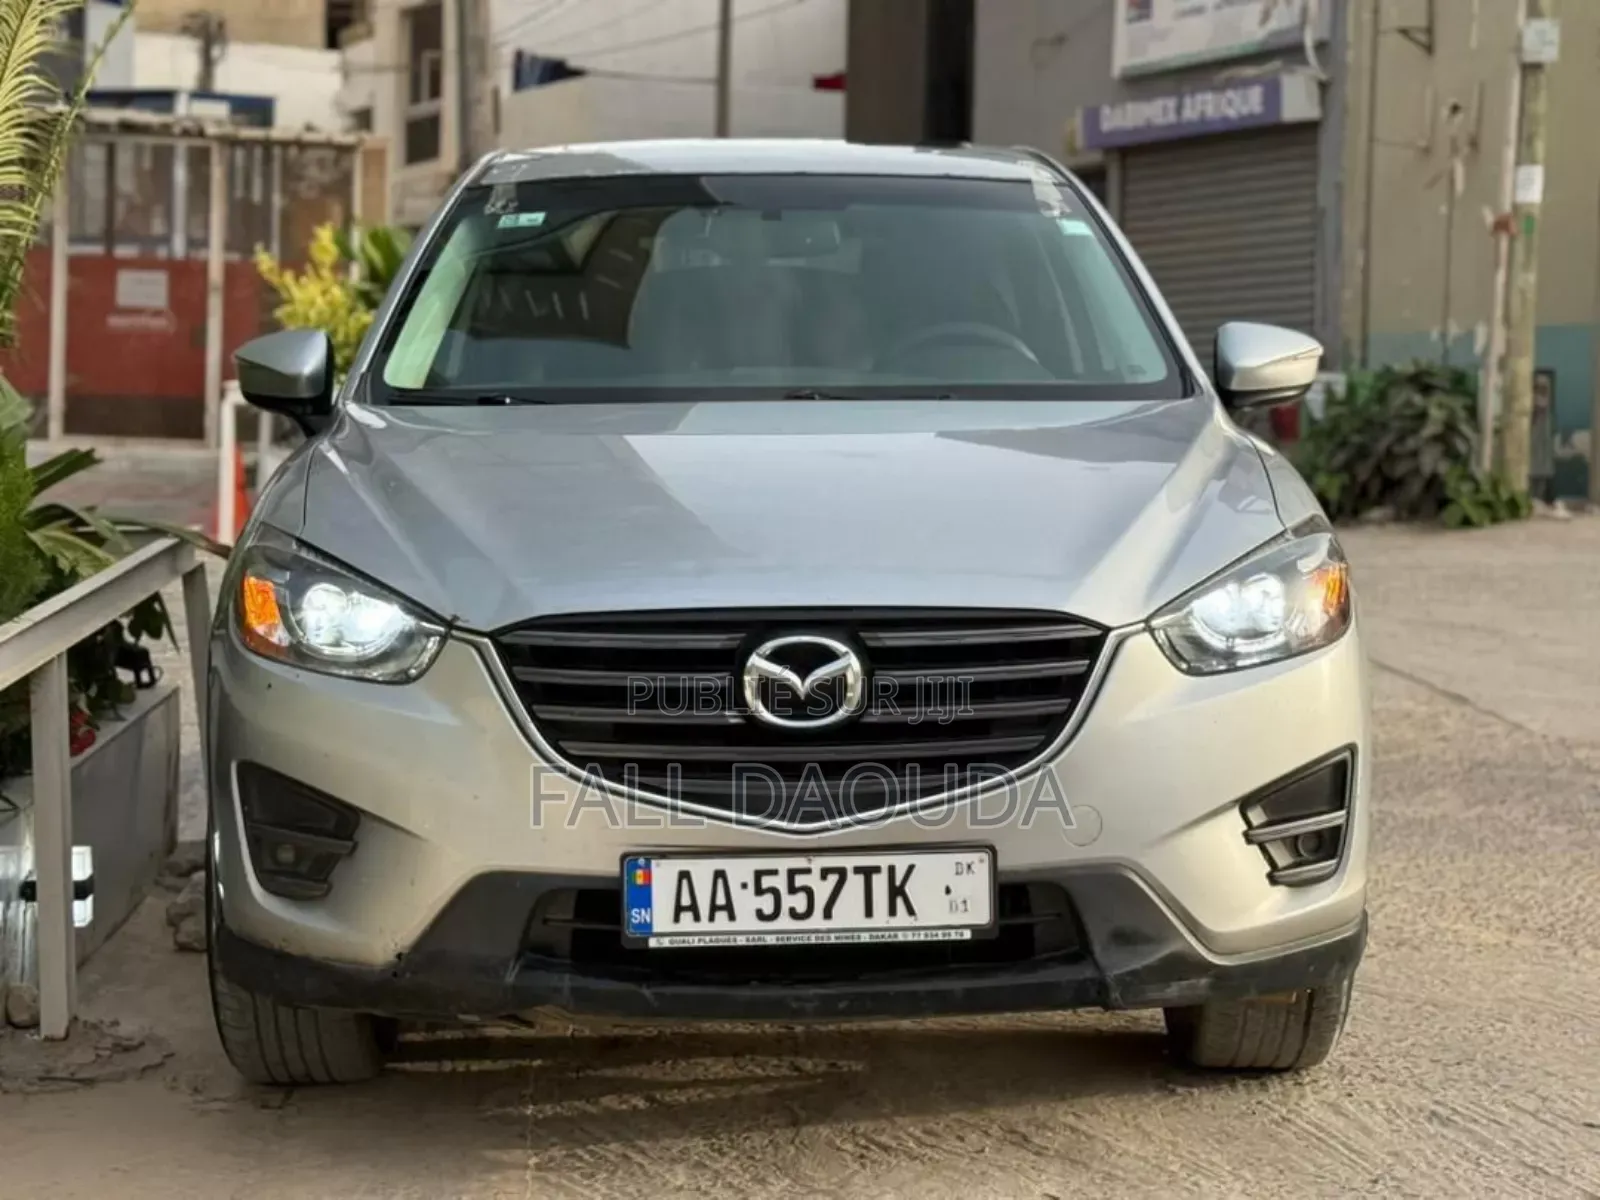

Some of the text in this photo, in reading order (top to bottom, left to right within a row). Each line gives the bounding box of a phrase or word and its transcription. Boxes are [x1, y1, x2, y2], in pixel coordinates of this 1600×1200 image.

[1181, 85, 1265, 122] AFRIQUE
[954, 860, 977, 877] DK
[631, 907, 651, 924] SN
[775, 933, 812, 943] SERVICE
[869, 931, 899, 941] DAKAR
